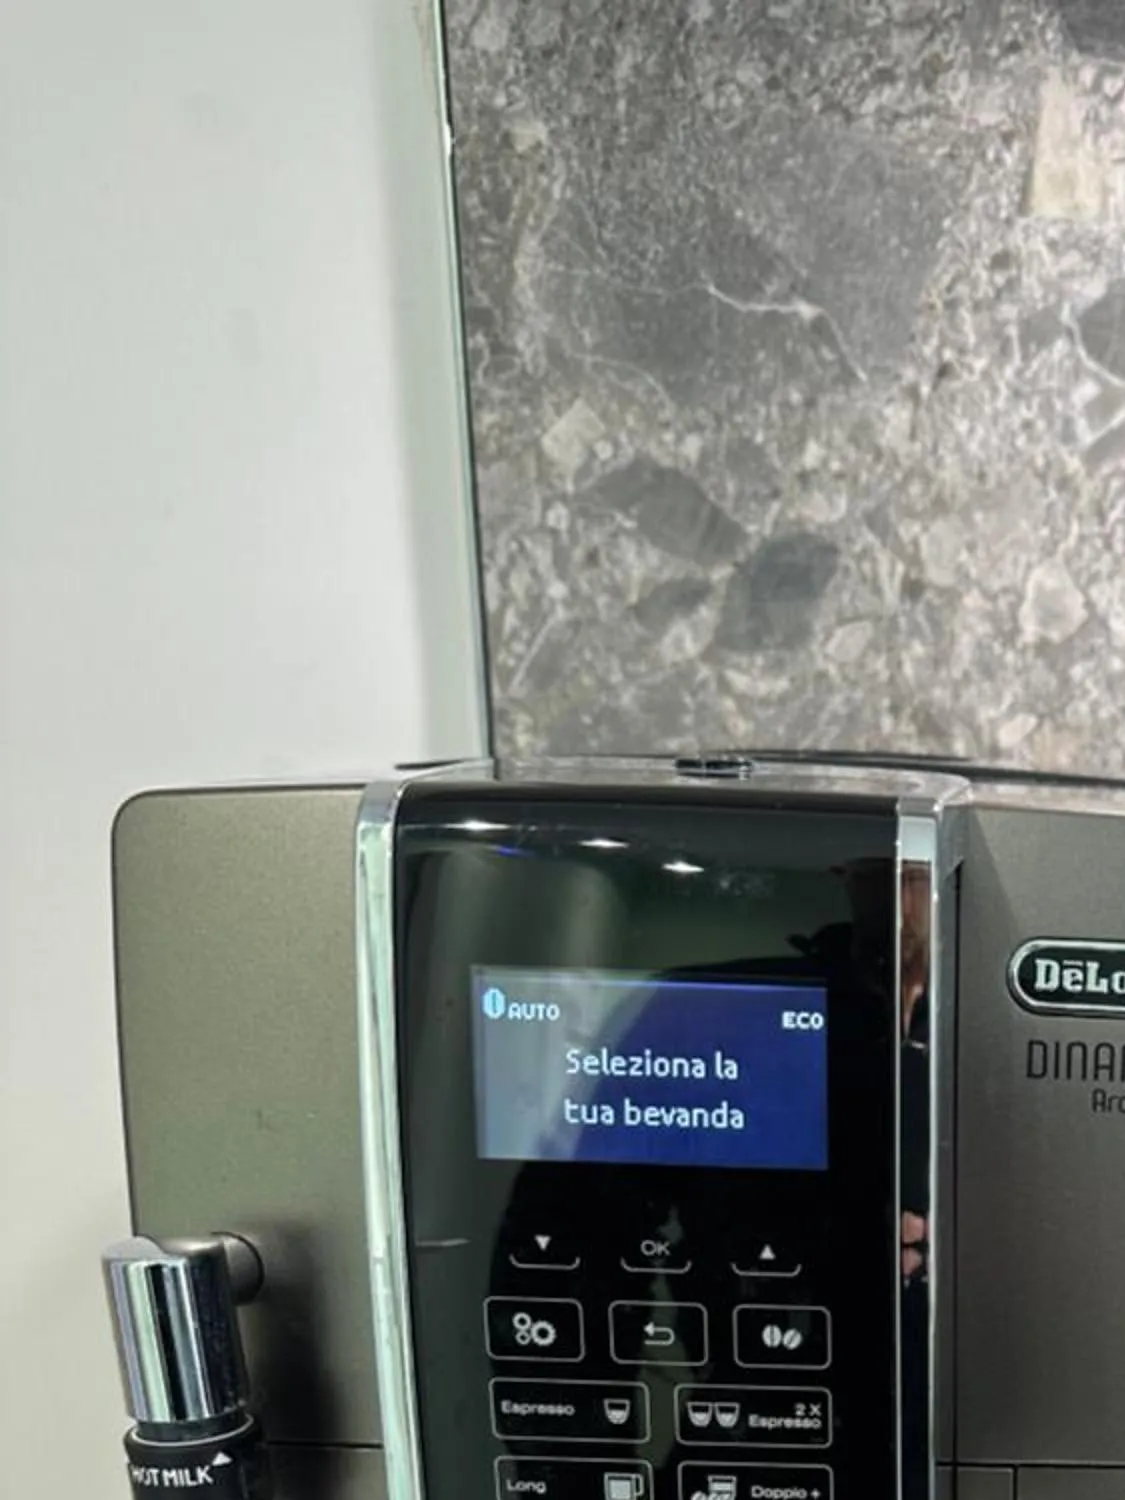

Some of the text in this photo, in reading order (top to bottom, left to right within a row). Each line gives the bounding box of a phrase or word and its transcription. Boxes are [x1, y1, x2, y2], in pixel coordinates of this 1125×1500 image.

[507, 1002, 561, 1022] AUTO
[781, 1011, 824, 1030] ECO
[565, 1048, 739, 1080] Seleziona la
[564, 1099, 745, 1129] tua bevanda
[640, 1239, 671, 1257] OK
[501, 1400, 576, 1418] Espresso
[794, 1403, 807, 1416] 2
[749, 1415, 822, 1430] Espresso
[161, 1464, 214, 1488] MILK
[506, 1478, 547, 1495] Long
[751, 1485, 808, 1500] Doppio
